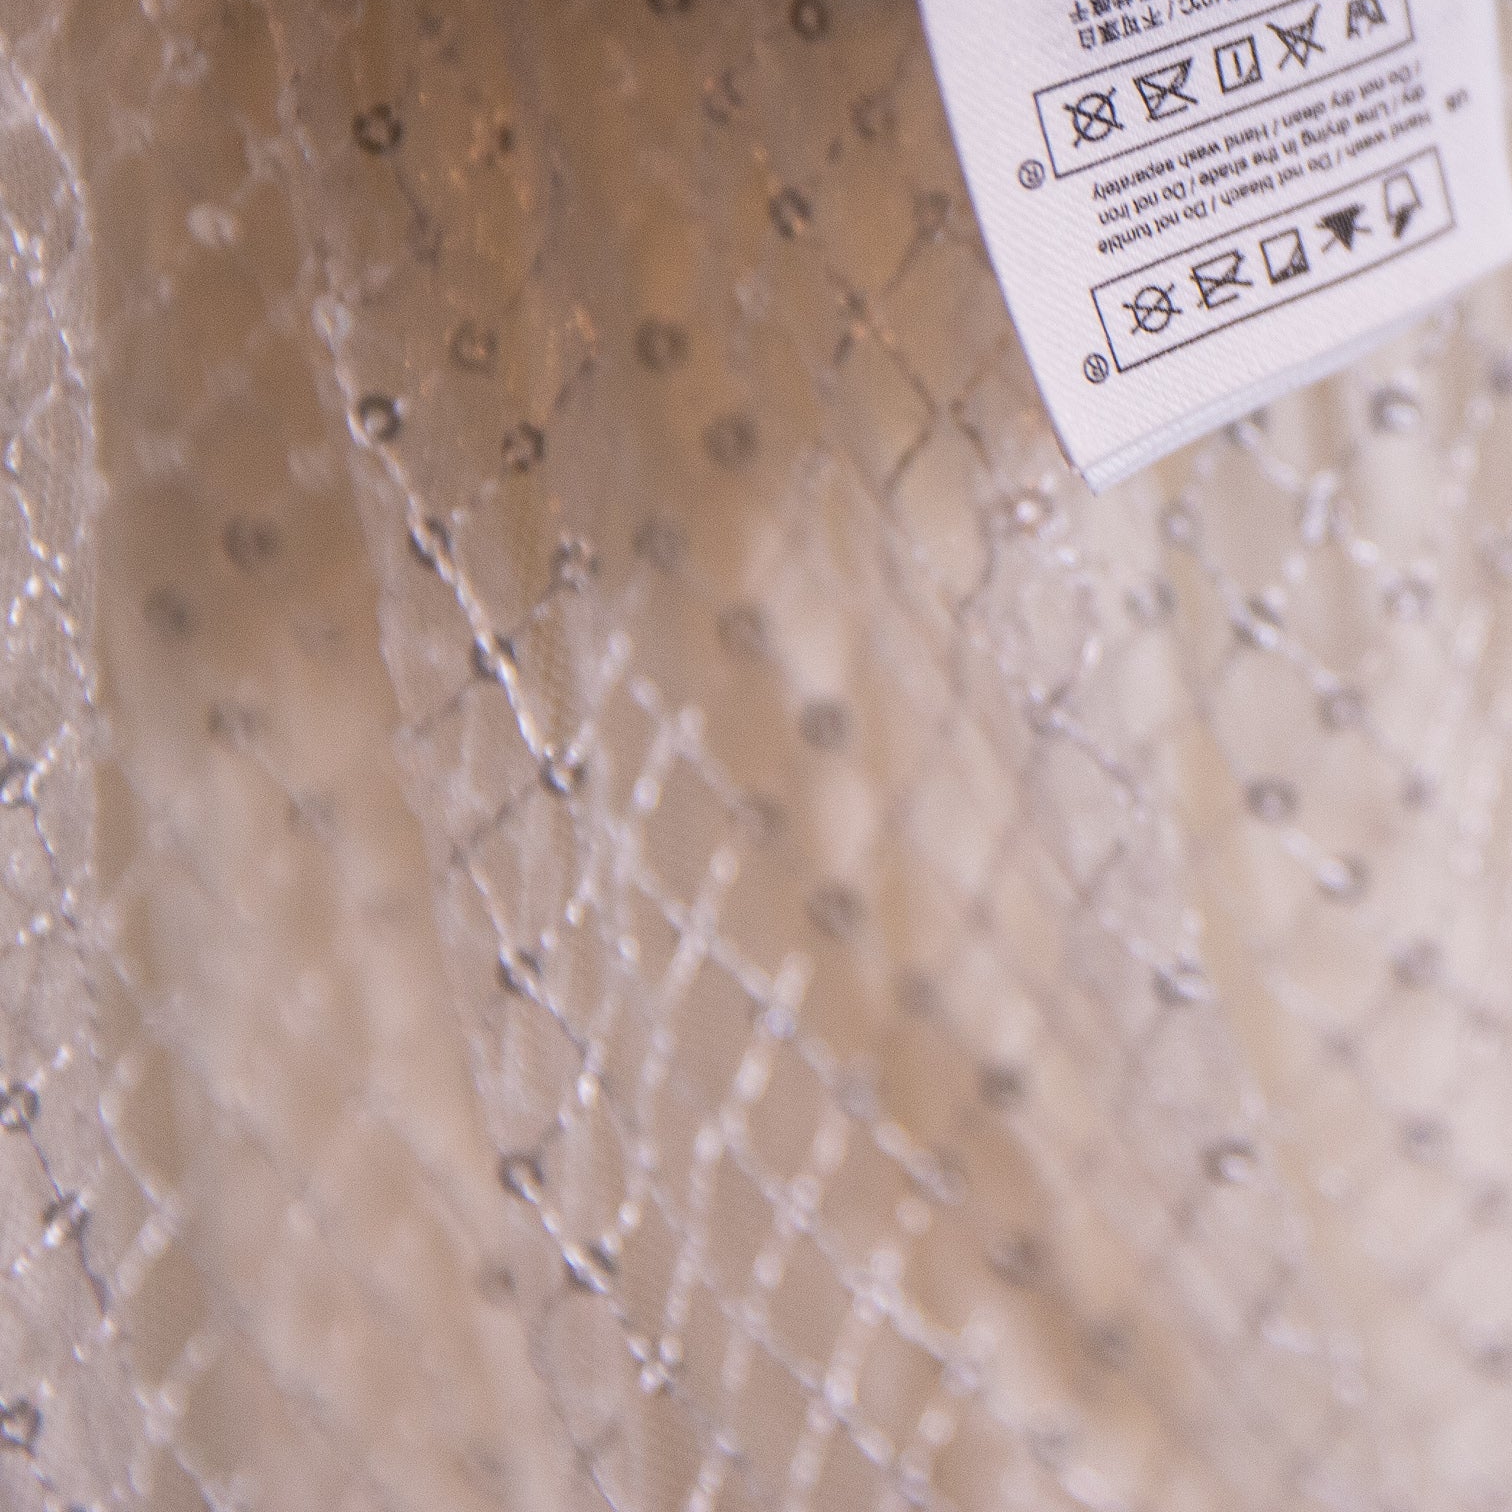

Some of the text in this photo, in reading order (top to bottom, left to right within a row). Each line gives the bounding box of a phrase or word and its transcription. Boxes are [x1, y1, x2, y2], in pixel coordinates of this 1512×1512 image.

[1386, 63, 1411, 85] Do
[1329, 88, 1356, 109] dry
[1357, 76, 1386, 100] not
[1400, 83, 1425, 105] dry
[1280, 100, 1327, 129] clean
[1353, 100, 1389, 126] Line
[1389, 111, 1431, 140] Hand
[1222, 122, 1269, 154] Hand
[1299, 116, 1351, 148] drying
[1344, 129, 1387, 158] wash
[1176, 140, 1221, 169] wash
[1250, 145, 1279, 166] the
[1280, 137, 1299, 156] in
[1197, 156, 1249, 187] shade
[1306, 151, 1332, 173] Do
[1092, 157, 1176, 201] separately
[1276, 163, 1303, 187] not
[1131, 190, 1159, 215] not
[1160, 180, 1187, 201] Do
[1218, 174, 1275, 207] bleach
[1097, 201, 1131, 226] iron
[1181, 198, 1208, 220] Do
[1153, 210, 1181, 234] not
[1097, 221, 1153, 255] tumble
